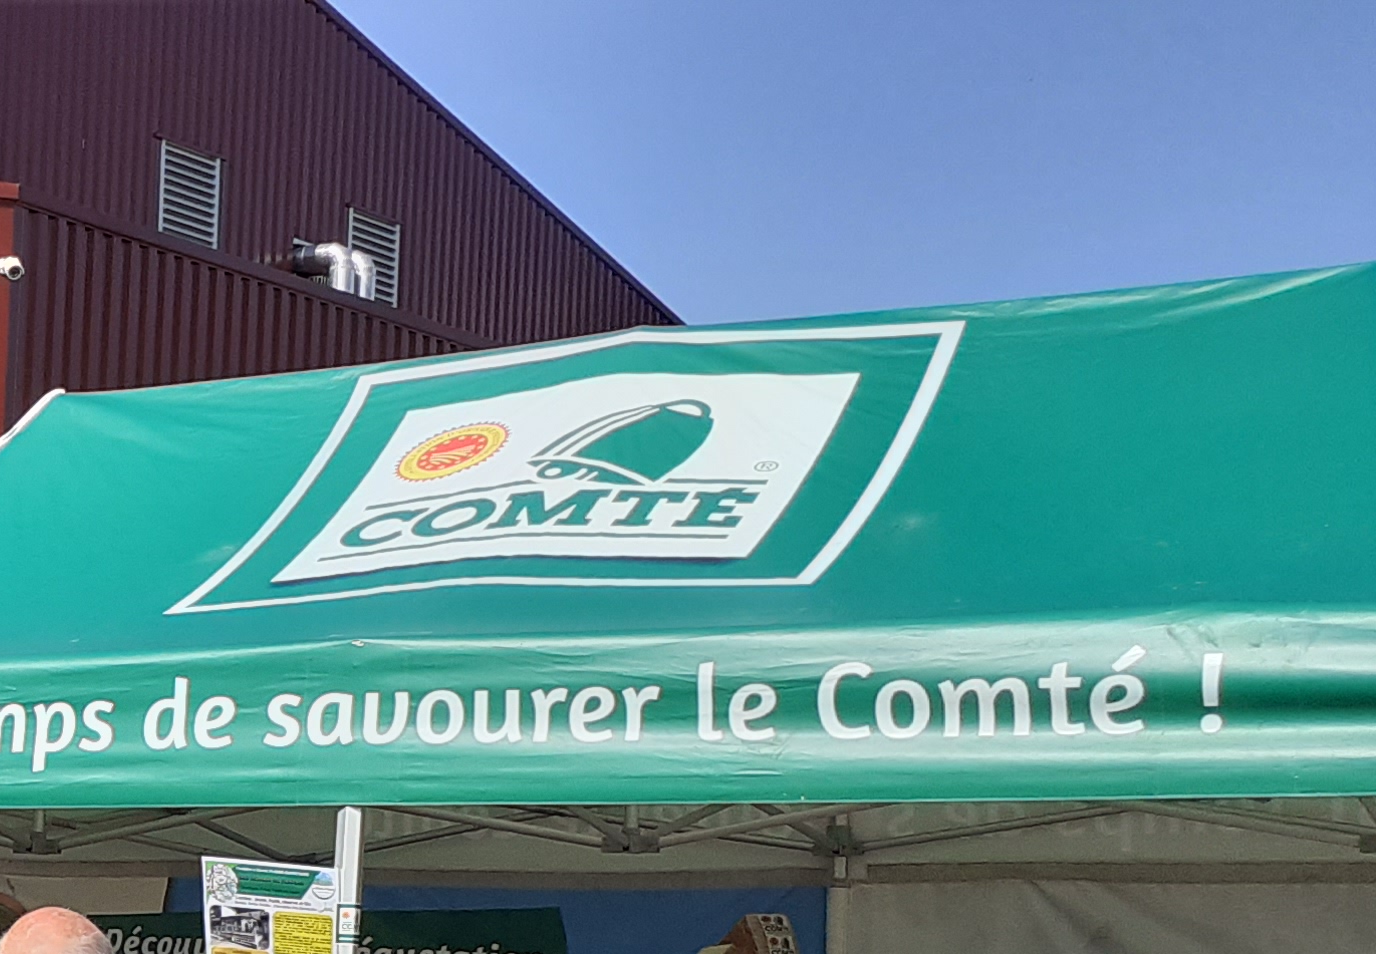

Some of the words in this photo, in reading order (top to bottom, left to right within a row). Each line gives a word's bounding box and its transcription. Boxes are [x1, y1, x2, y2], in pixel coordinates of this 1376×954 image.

[340, 487, 761, 547] COMTÉ
[143, 676, 235, 750] de
[262, 681, 661, 748] savourer
[696, 661, 778, 742] le
[816, 644, 1146, 740] Comté
